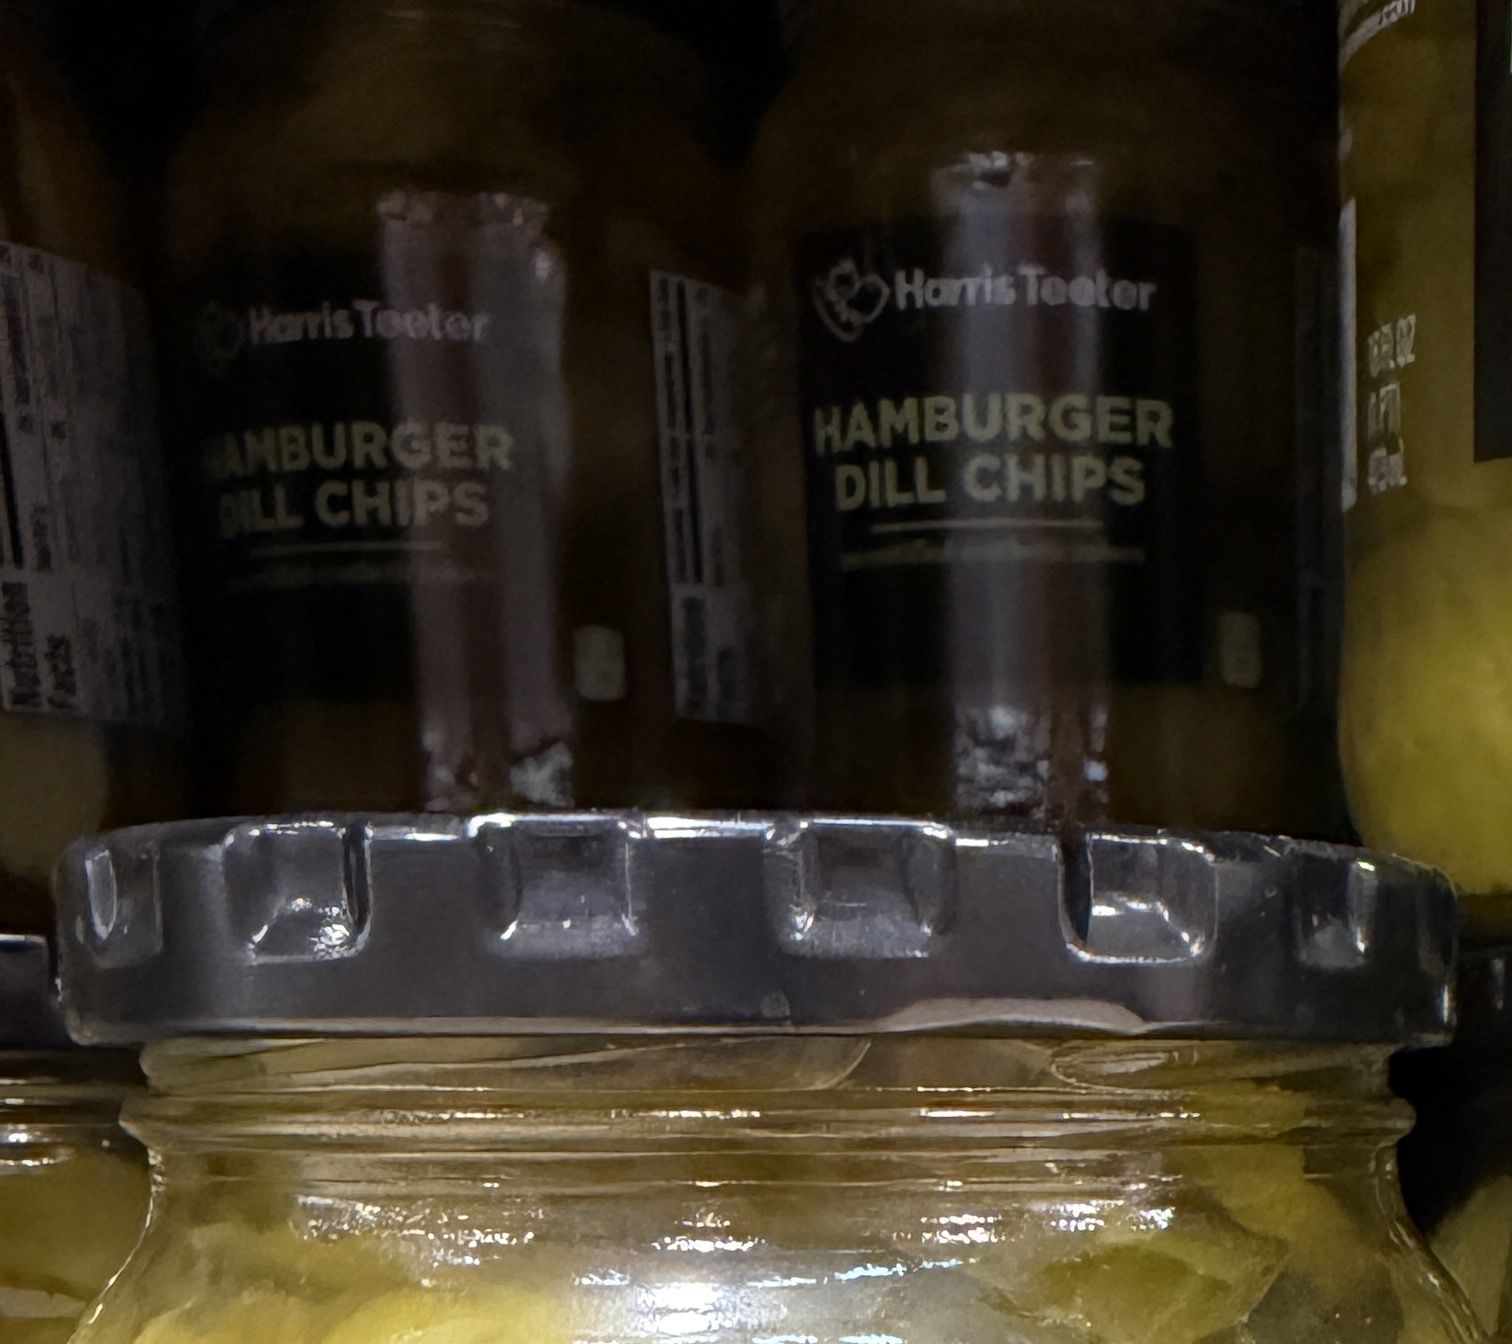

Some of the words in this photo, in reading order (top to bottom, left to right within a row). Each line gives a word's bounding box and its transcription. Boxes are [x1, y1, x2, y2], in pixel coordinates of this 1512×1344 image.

[895, 265, 1015, 312] Harris
[1019, 263, 1157, 312] Teeter
[248, 304, 353, 345] Harris
[813, 393, 1175, 457] HAMBURGER
[314, 479, 491, 528] CHIPS
[834, 456, 946, 512] DILL
[962, 453, 1146, 506] CHIPS
